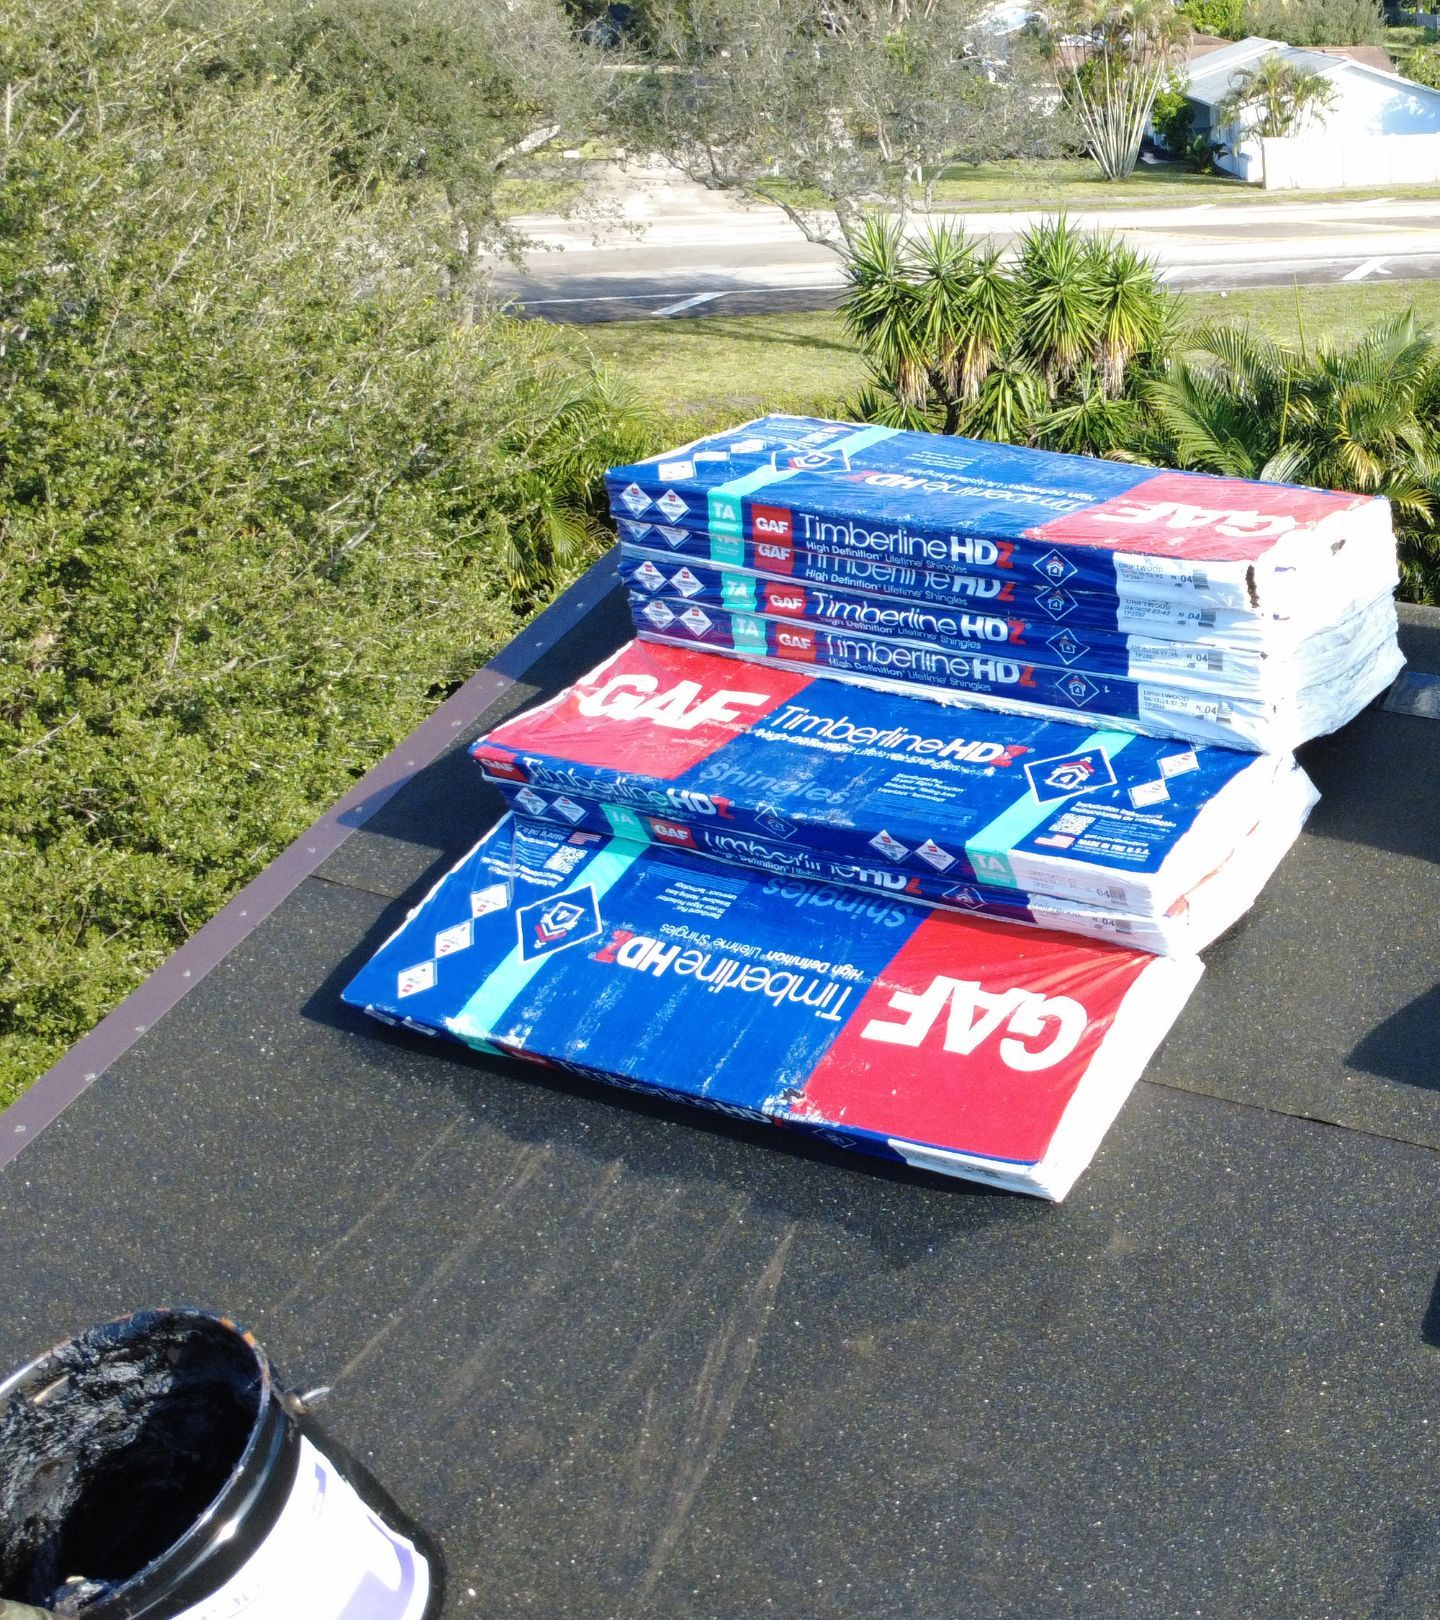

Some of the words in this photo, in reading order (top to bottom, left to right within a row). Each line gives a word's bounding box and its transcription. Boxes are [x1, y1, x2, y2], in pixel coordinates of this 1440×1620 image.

[713, 501, 735, 520] TA
[1092, 501, 1297, 538] GAF
[756, 517, 789, 534] GAF
[758, 543, 791, 560] GAF
[799, 513, 947, 560] Timberline
[950, 535, 1017, 569] HDZ
[806, 541, 829, 554] High
[832, 545, 880, 561] Definition
[926, 560, 967, 574] Shingles
[727, 581, 747, 598] TA
[805, 569, 829, 583] High
[831, 574, 879, 592] Definition
[925, 590, 968, 606] Shingles
[1181, 575, 1193, 584] 04
[769, 593, 803, 610] GAF
[737, 619, 759, 636] TA
[812, 592, 958, 637] Timberline
[961, 614, 1027, 645] HDZ
[778, 633, 812, 650] GAF
[941, 635, 982, 650] Shingles
[824, 634, 970, 678] Timberline
[972, 656, 1038, 688] HDZ
[950, 677, 992, 692] Shingles
[579, 674, 772, 730] GAF
[1205, 705, 1217, 715] 04
[770, 704, 944, 753] Timberline
[480, 757, 515, 773] GAF
[523, 756, 668, 807] Timberline
[654, 823, 689, 841] GAF
[974, 853, 1008, 873] TA
[762, 876, 914, 929] Shingles
[660, 922, 711, 948] Shingles
[593, 929, 675, 977] HDZ
[713, 936, 763, 962] Lifetime
[767, 949, 830, 977] Definition
[831, 960, 865, 983] High
[672, 948, 854, 1024] Timberline
[860, 973, 1088, 1072] GAF
